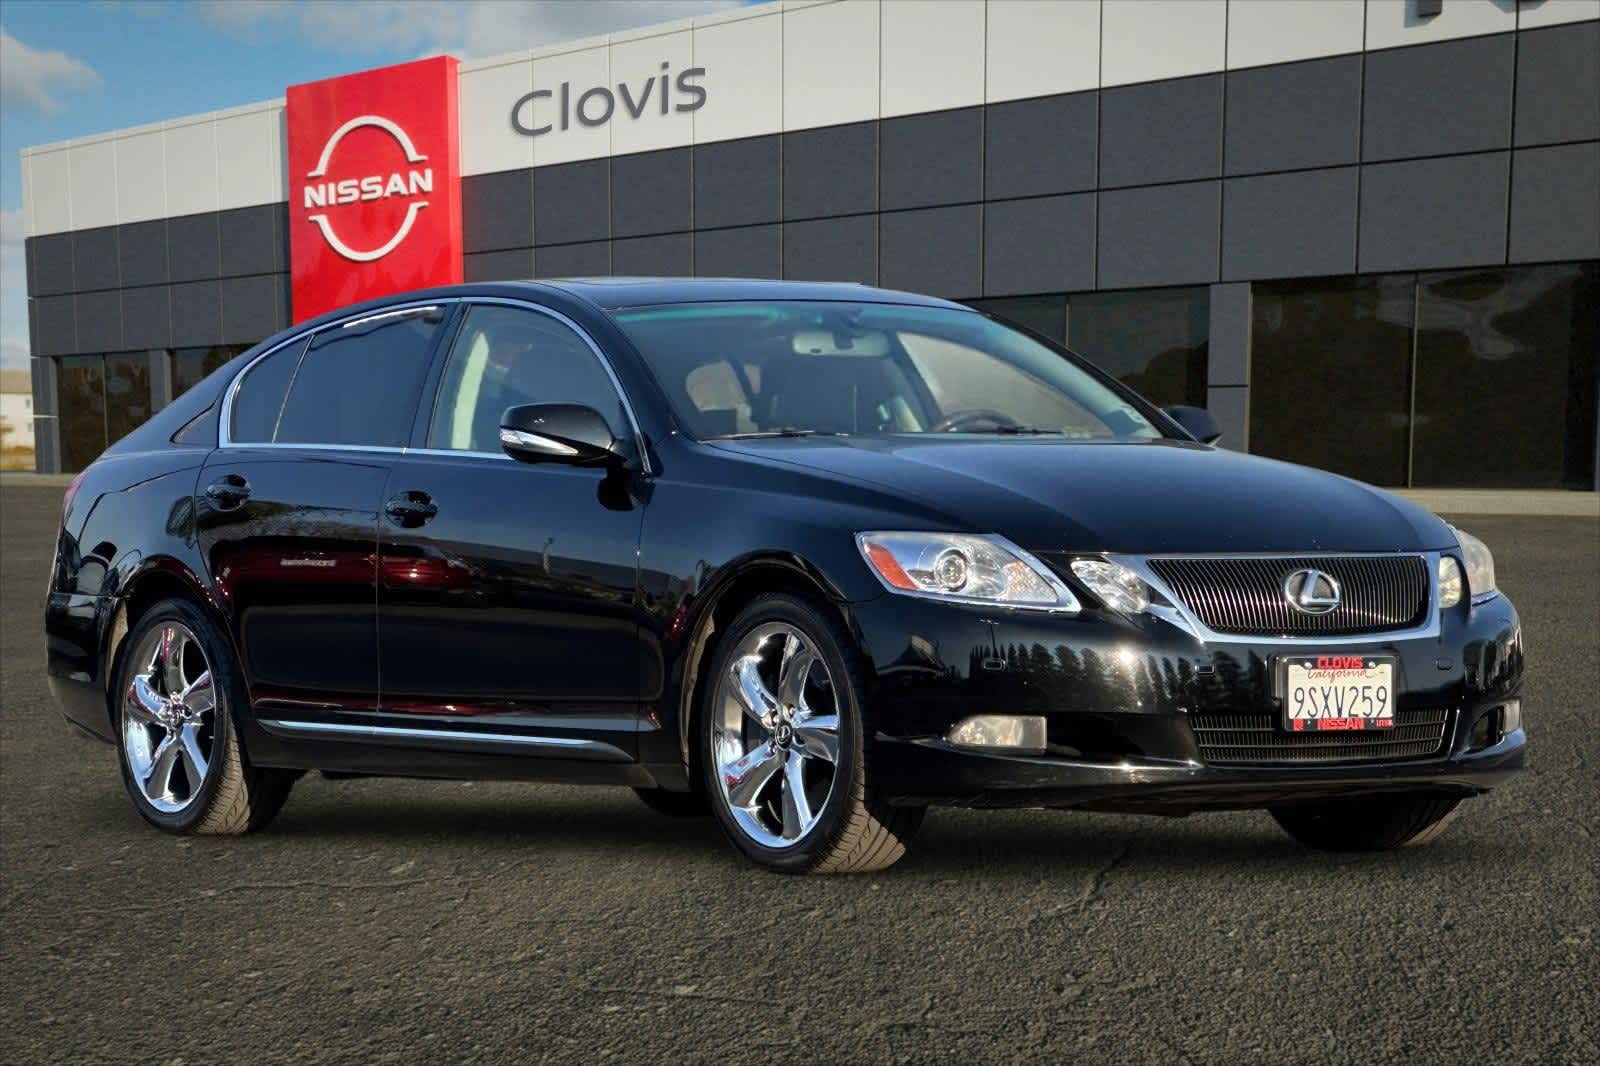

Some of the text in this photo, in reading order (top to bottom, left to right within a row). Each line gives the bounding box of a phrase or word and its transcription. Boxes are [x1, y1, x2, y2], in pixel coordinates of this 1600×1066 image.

[511, 61, 707, 136] Clovis
[304, 168, 433, 208] NISSAN
[1318, 656, 1363, 669] CLOVIS
[1294, 686, 1388, 718] 9SXV259
[1318, 718, 1364, 730] NISSAN
